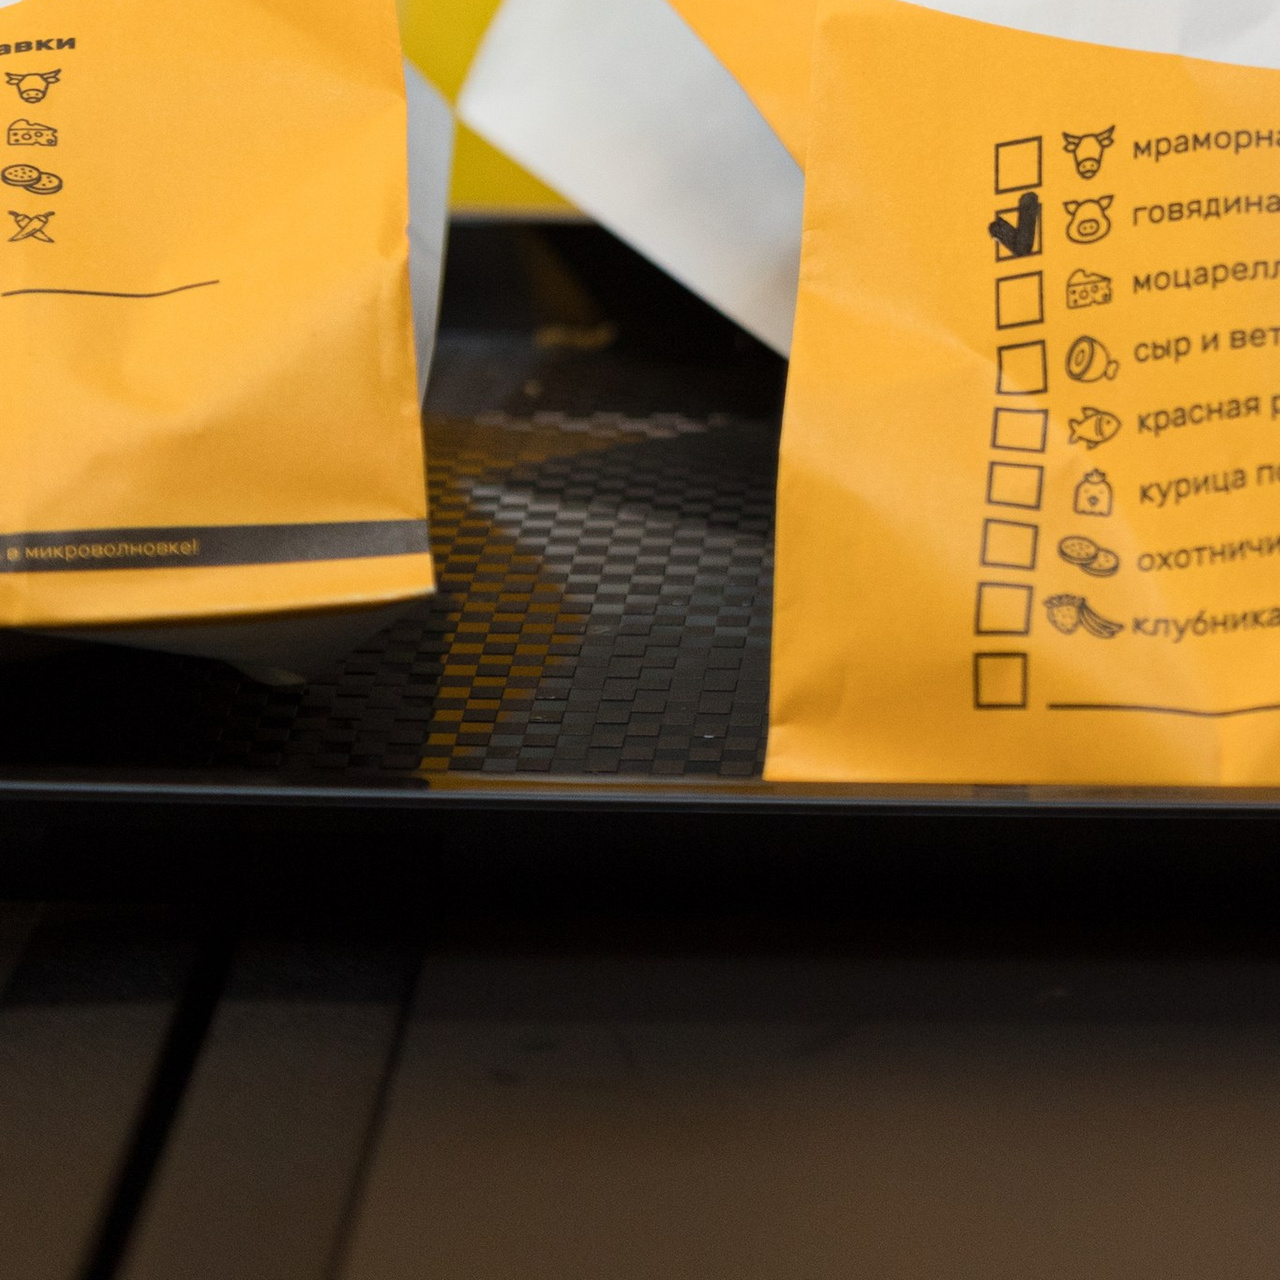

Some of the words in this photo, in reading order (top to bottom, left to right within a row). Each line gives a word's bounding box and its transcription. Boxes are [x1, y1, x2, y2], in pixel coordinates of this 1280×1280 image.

[0, 37, 76, 56] авки
[1133, 332, 1191, 364] сыр
[1201, 331, 1220, 352] и
[1137, 398, 1260, 438] красная
[1138, 465, 1246, 507] курица
[25, 538, 199, 562] микроволновке!
